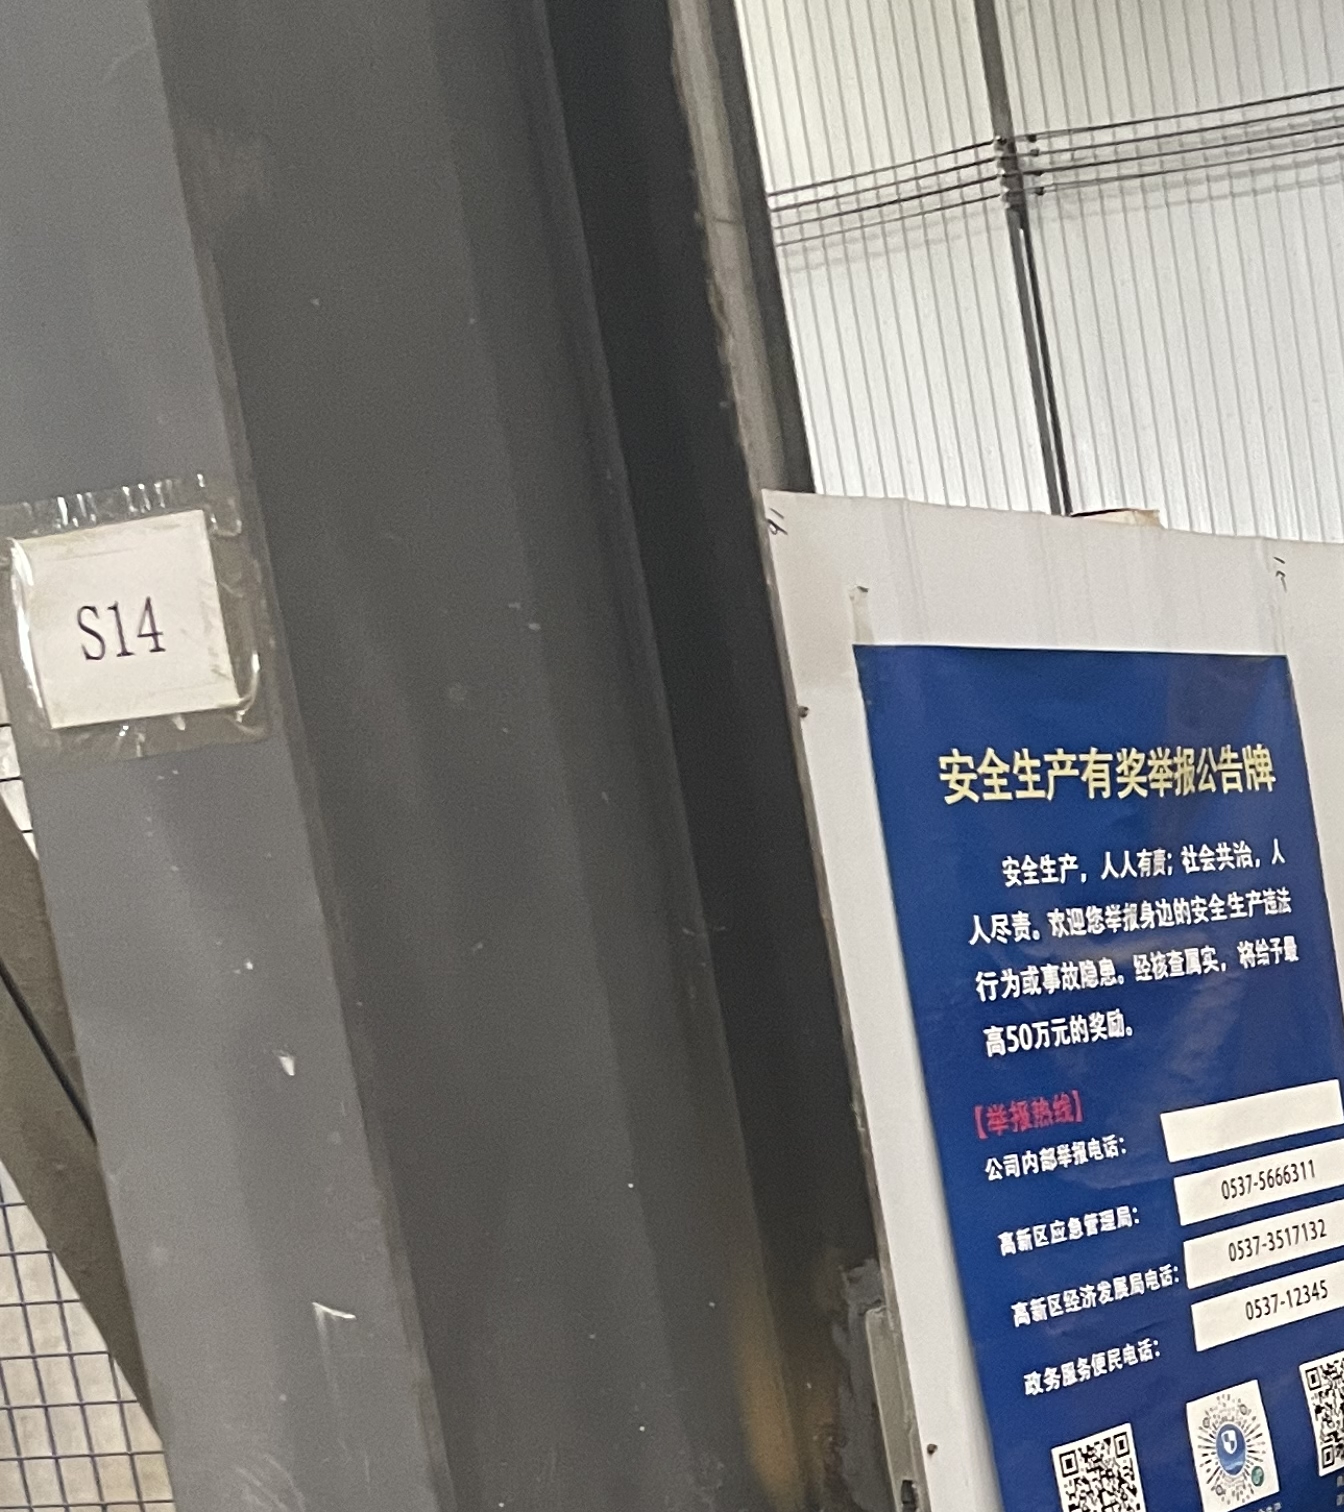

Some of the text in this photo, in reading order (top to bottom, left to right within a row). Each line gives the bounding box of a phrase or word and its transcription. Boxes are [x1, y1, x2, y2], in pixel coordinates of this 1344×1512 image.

[76, 596, 167, 662] S14
[938, 743, 1277, 805] 安全生产有奖举报公告牌
[983, 1008, 1135, 1058] 高50万元的奖励。
[974, 1089, 1083, 1140] 【举报热线】
[984, 1134, 1127, 1182] 公司内部举报电话：
[1221, 1159, 1316, 1200] 0537-5666311
[998, 1205, 1140, 1256] 高新区应急管理局：
[1229, 1218, 1327, 1262] 0537-3517132
[1011, 1264, 1179, 1328] 高新区经济发展局电话：
[1245, 1279, 1329, 1321] 0537-12345
[1024, 1338, 1160, 1396] 政务服务便民电话：
